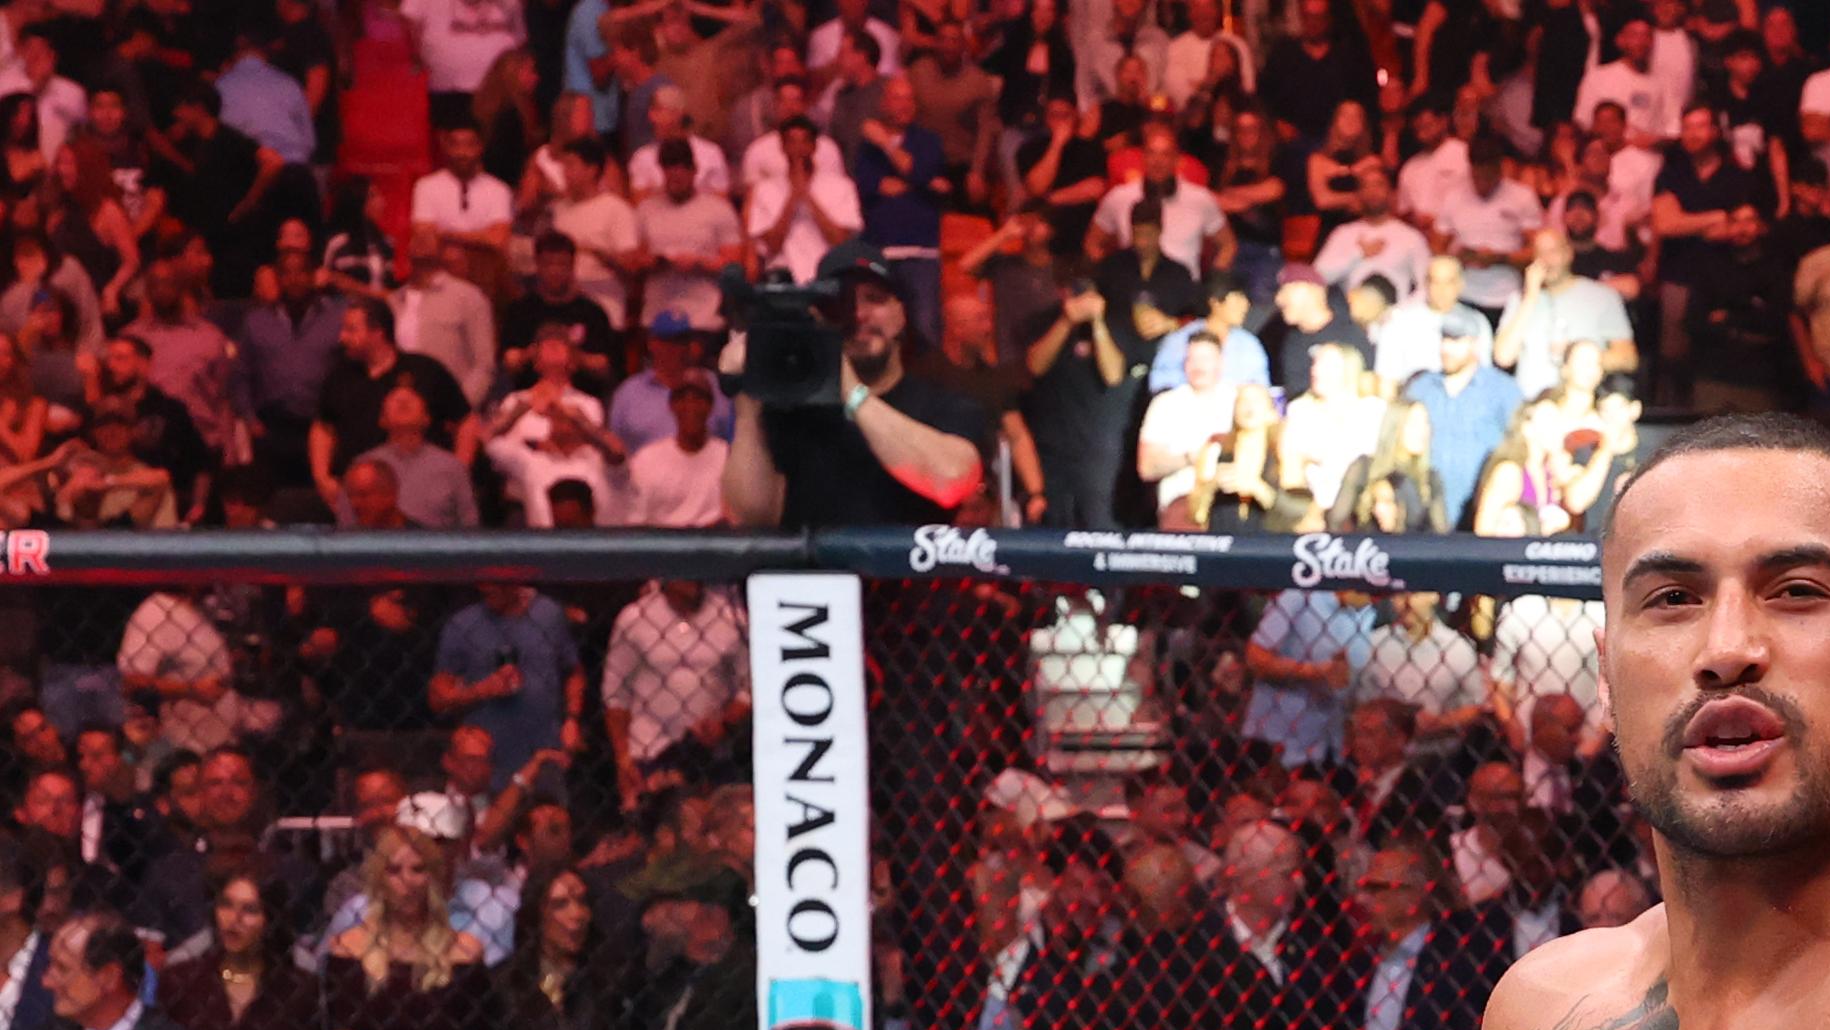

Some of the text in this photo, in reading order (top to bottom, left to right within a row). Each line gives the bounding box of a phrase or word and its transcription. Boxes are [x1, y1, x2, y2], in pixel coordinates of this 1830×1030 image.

[0, 529, 50, 576] R
[909, 523, 998, 573] Stake
[1291, 533, 1391, 588] Stake
[1525, 541, 1598, 561] CASINO
[1503, 564, 1602, 586] EXPERIENC
[777, 599, 840, 953] MONACO
